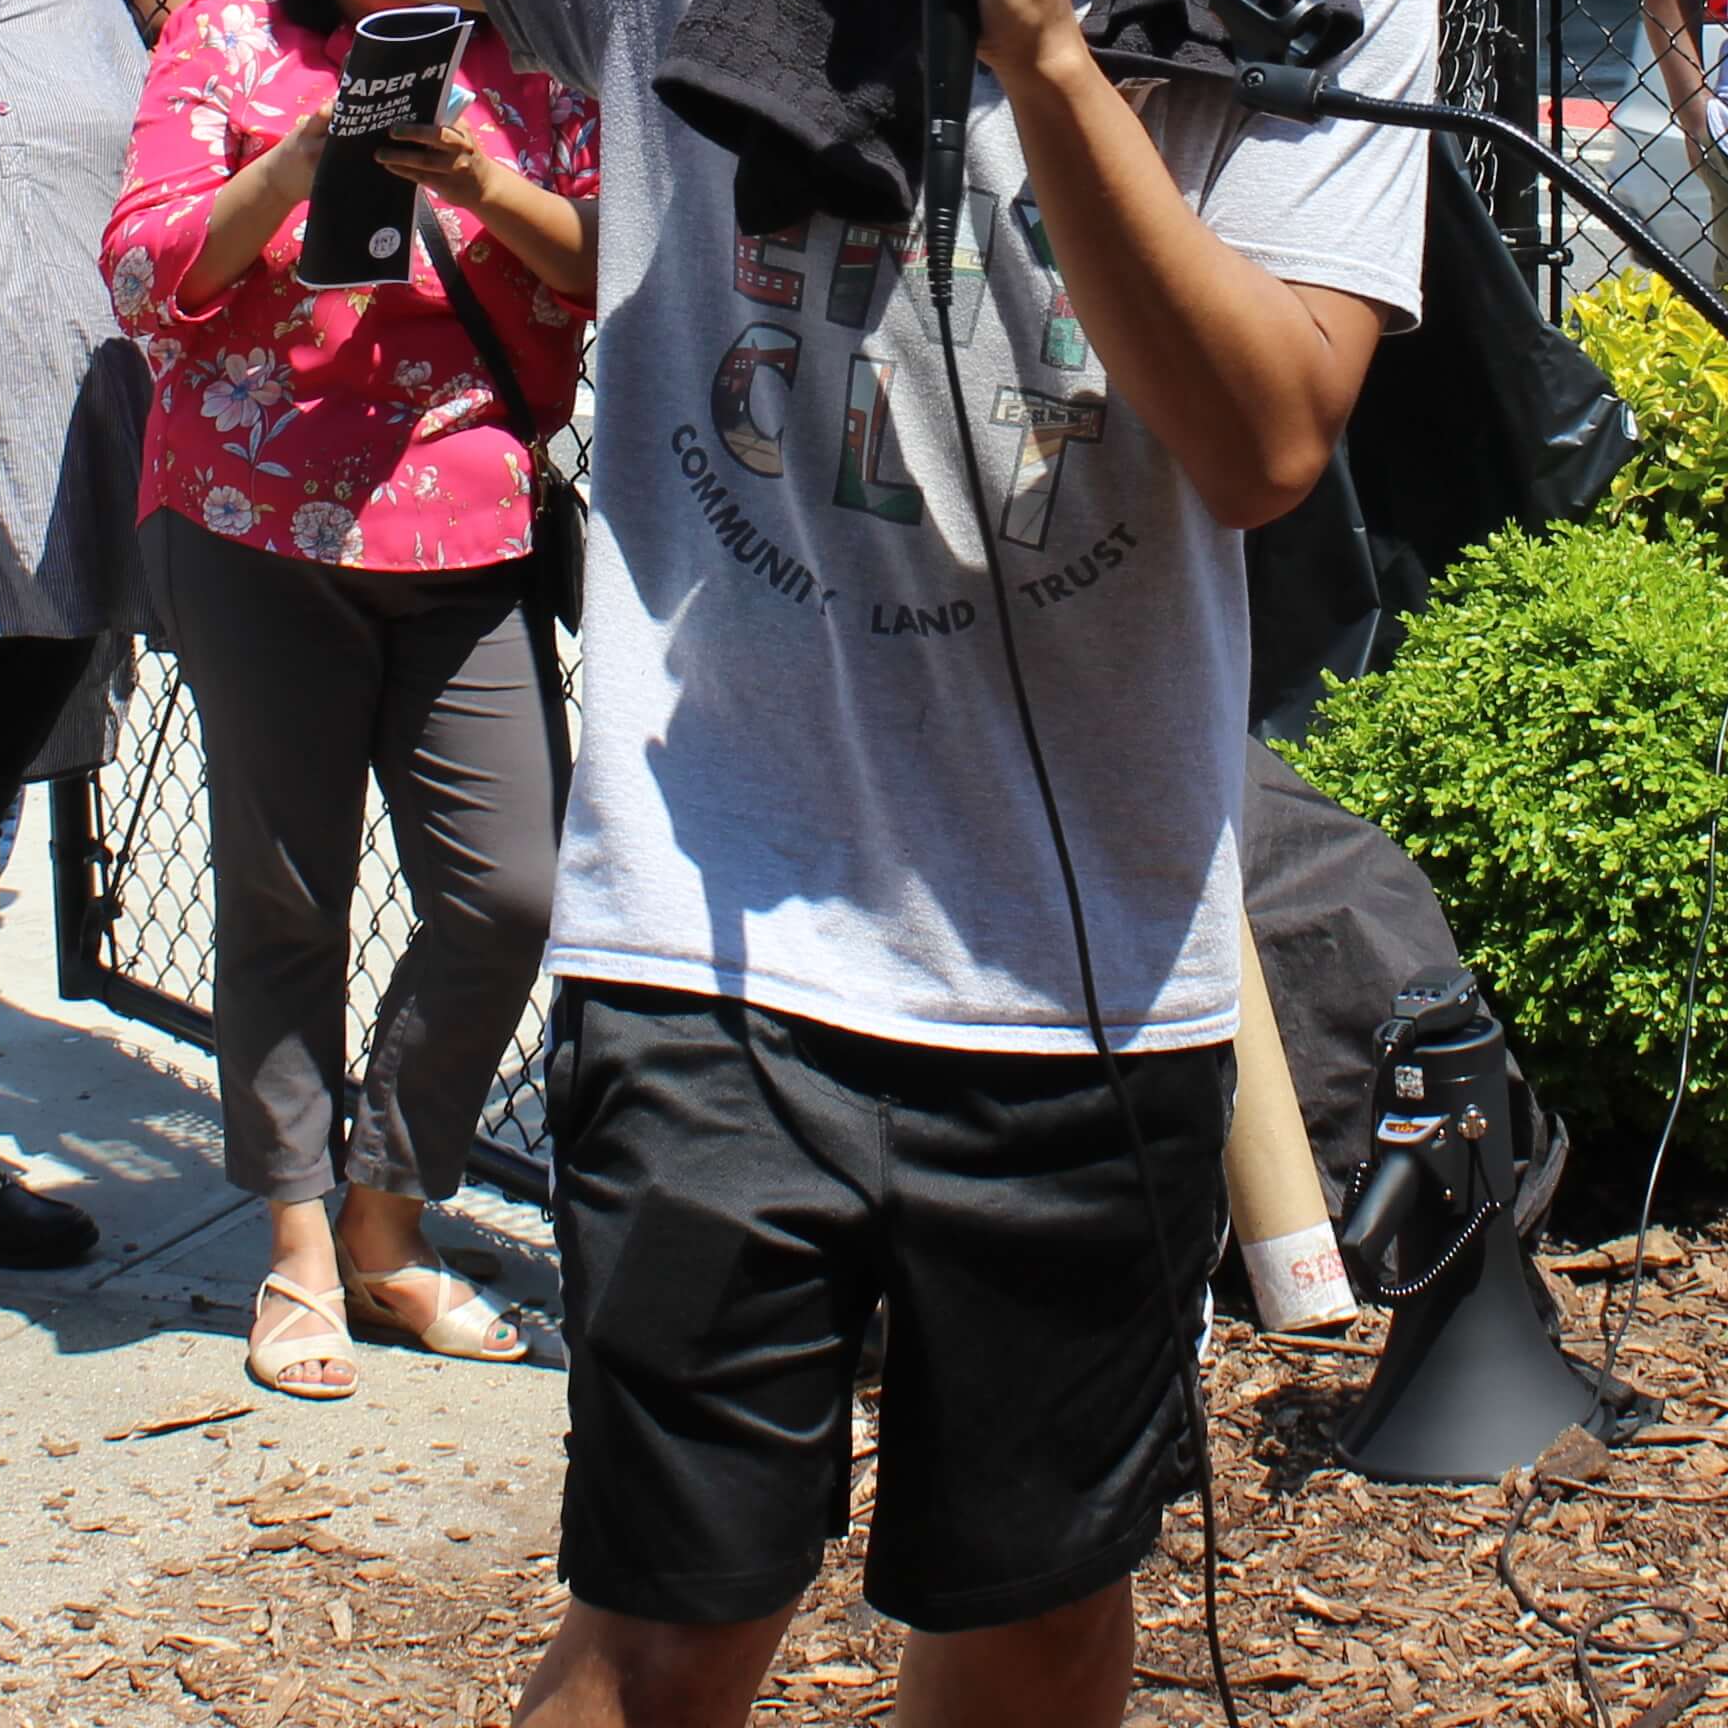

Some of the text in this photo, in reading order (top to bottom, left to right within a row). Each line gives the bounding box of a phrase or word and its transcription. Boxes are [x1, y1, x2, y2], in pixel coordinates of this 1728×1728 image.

[333, 112, 360, 126] THE
[397, 104, 412, 115] IN
[349, 102, 375, 115] THE
[376, 95, 410, 112] LAND
[337, 124, 367, 137] AND
[671, 424, 1140, 637] COMMUNITY LAND TRUST
